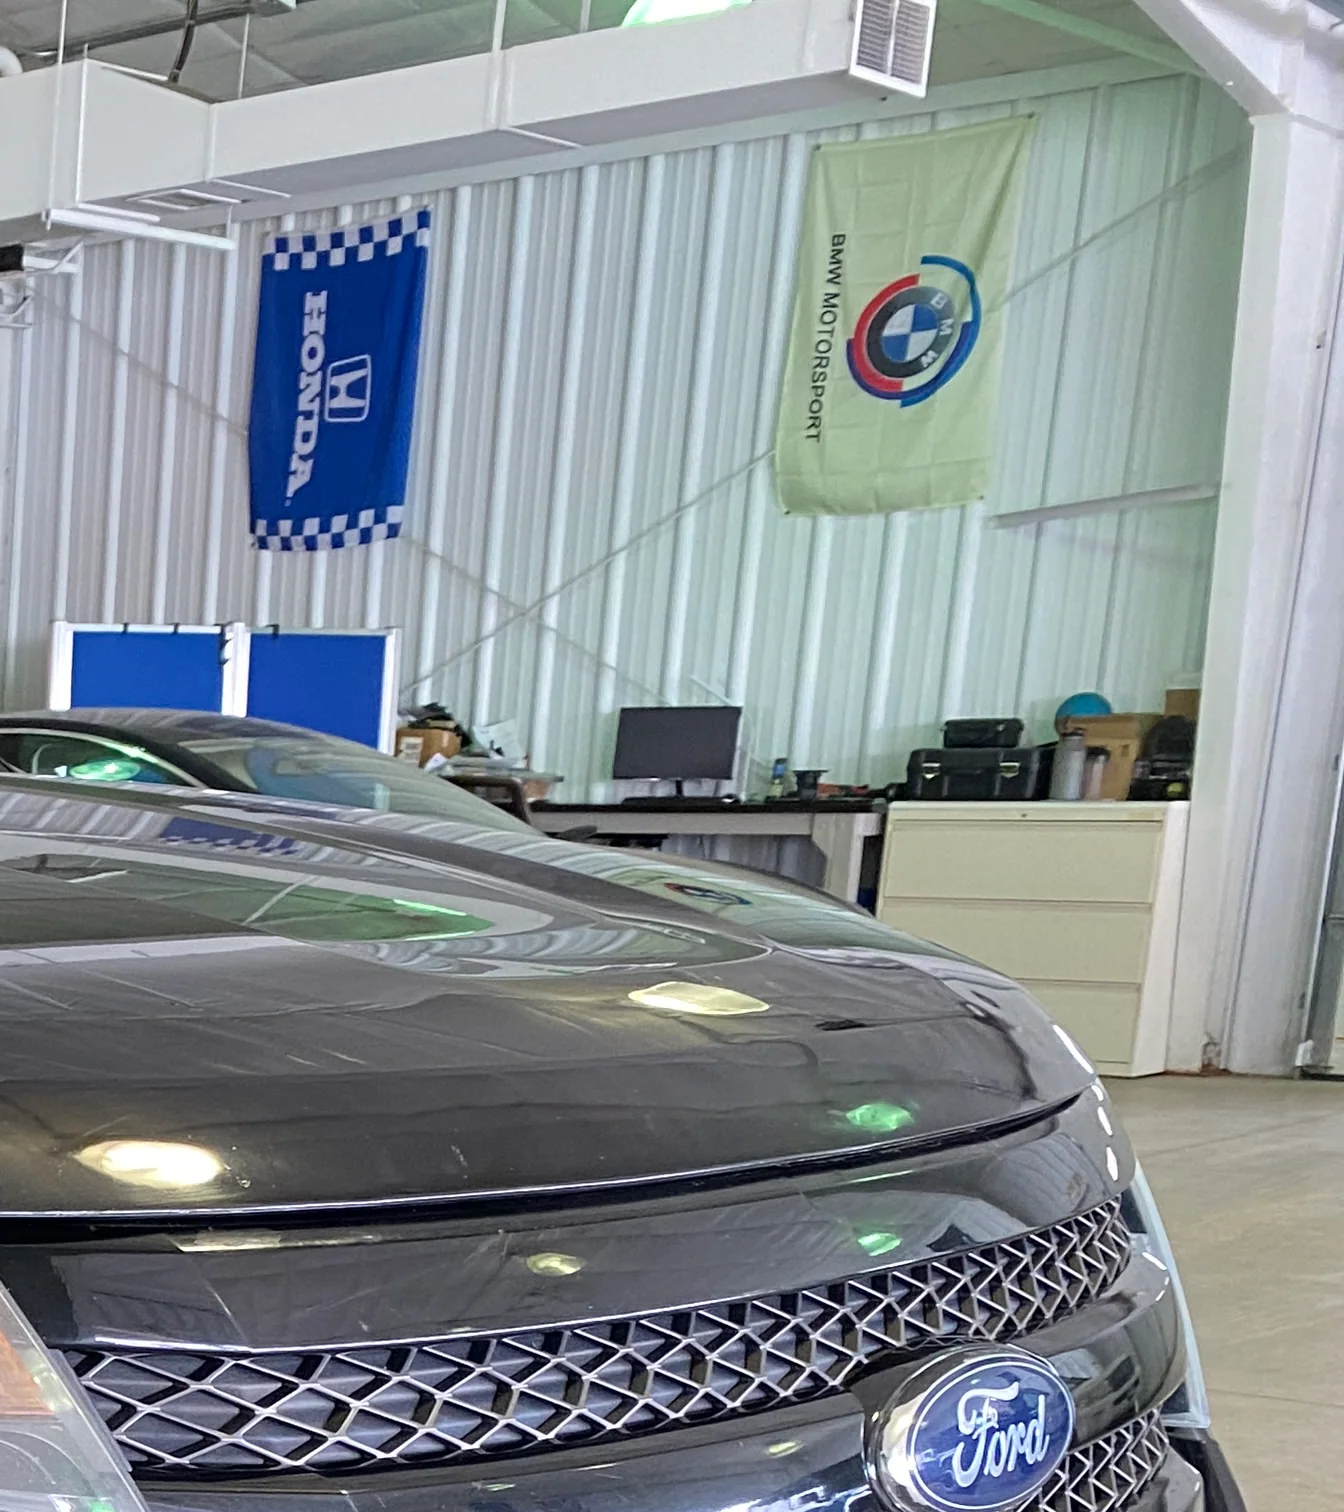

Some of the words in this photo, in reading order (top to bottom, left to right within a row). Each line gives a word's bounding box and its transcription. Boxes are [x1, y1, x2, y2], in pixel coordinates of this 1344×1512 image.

[828, 232, 847, 288] BMW
[284, 289, 328, 507] HONDA
[804, 292, 842, 444] MOTORSPORT
[951, 1380, 1051, 1488] Ford
